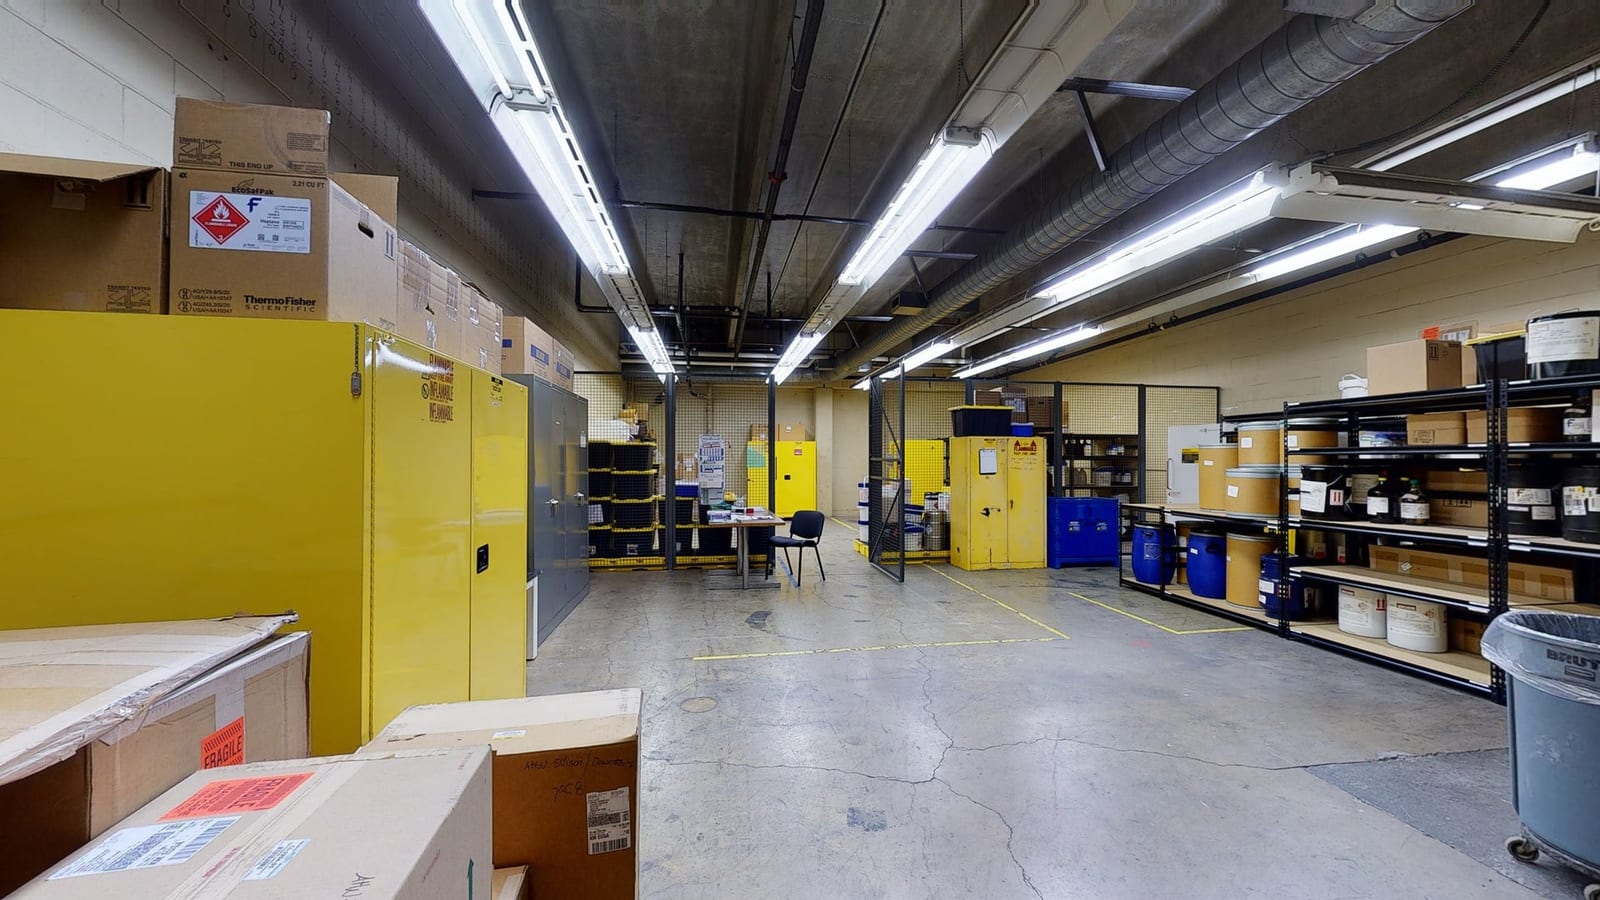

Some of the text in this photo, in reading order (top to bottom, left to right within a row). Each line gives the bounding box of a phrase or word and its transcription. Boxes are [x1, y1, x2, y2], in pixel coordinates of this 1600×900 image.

[229, 161, 246, 169] THIS
[292, 180, 305, 188] 2.21
[231, 186, 274, 195] EcoSafPak
[246, 197, 262, 213] F
[244, 304, 316, 313] SCIENTIFIC
[204, 735, 242, 769] FRAGILE
